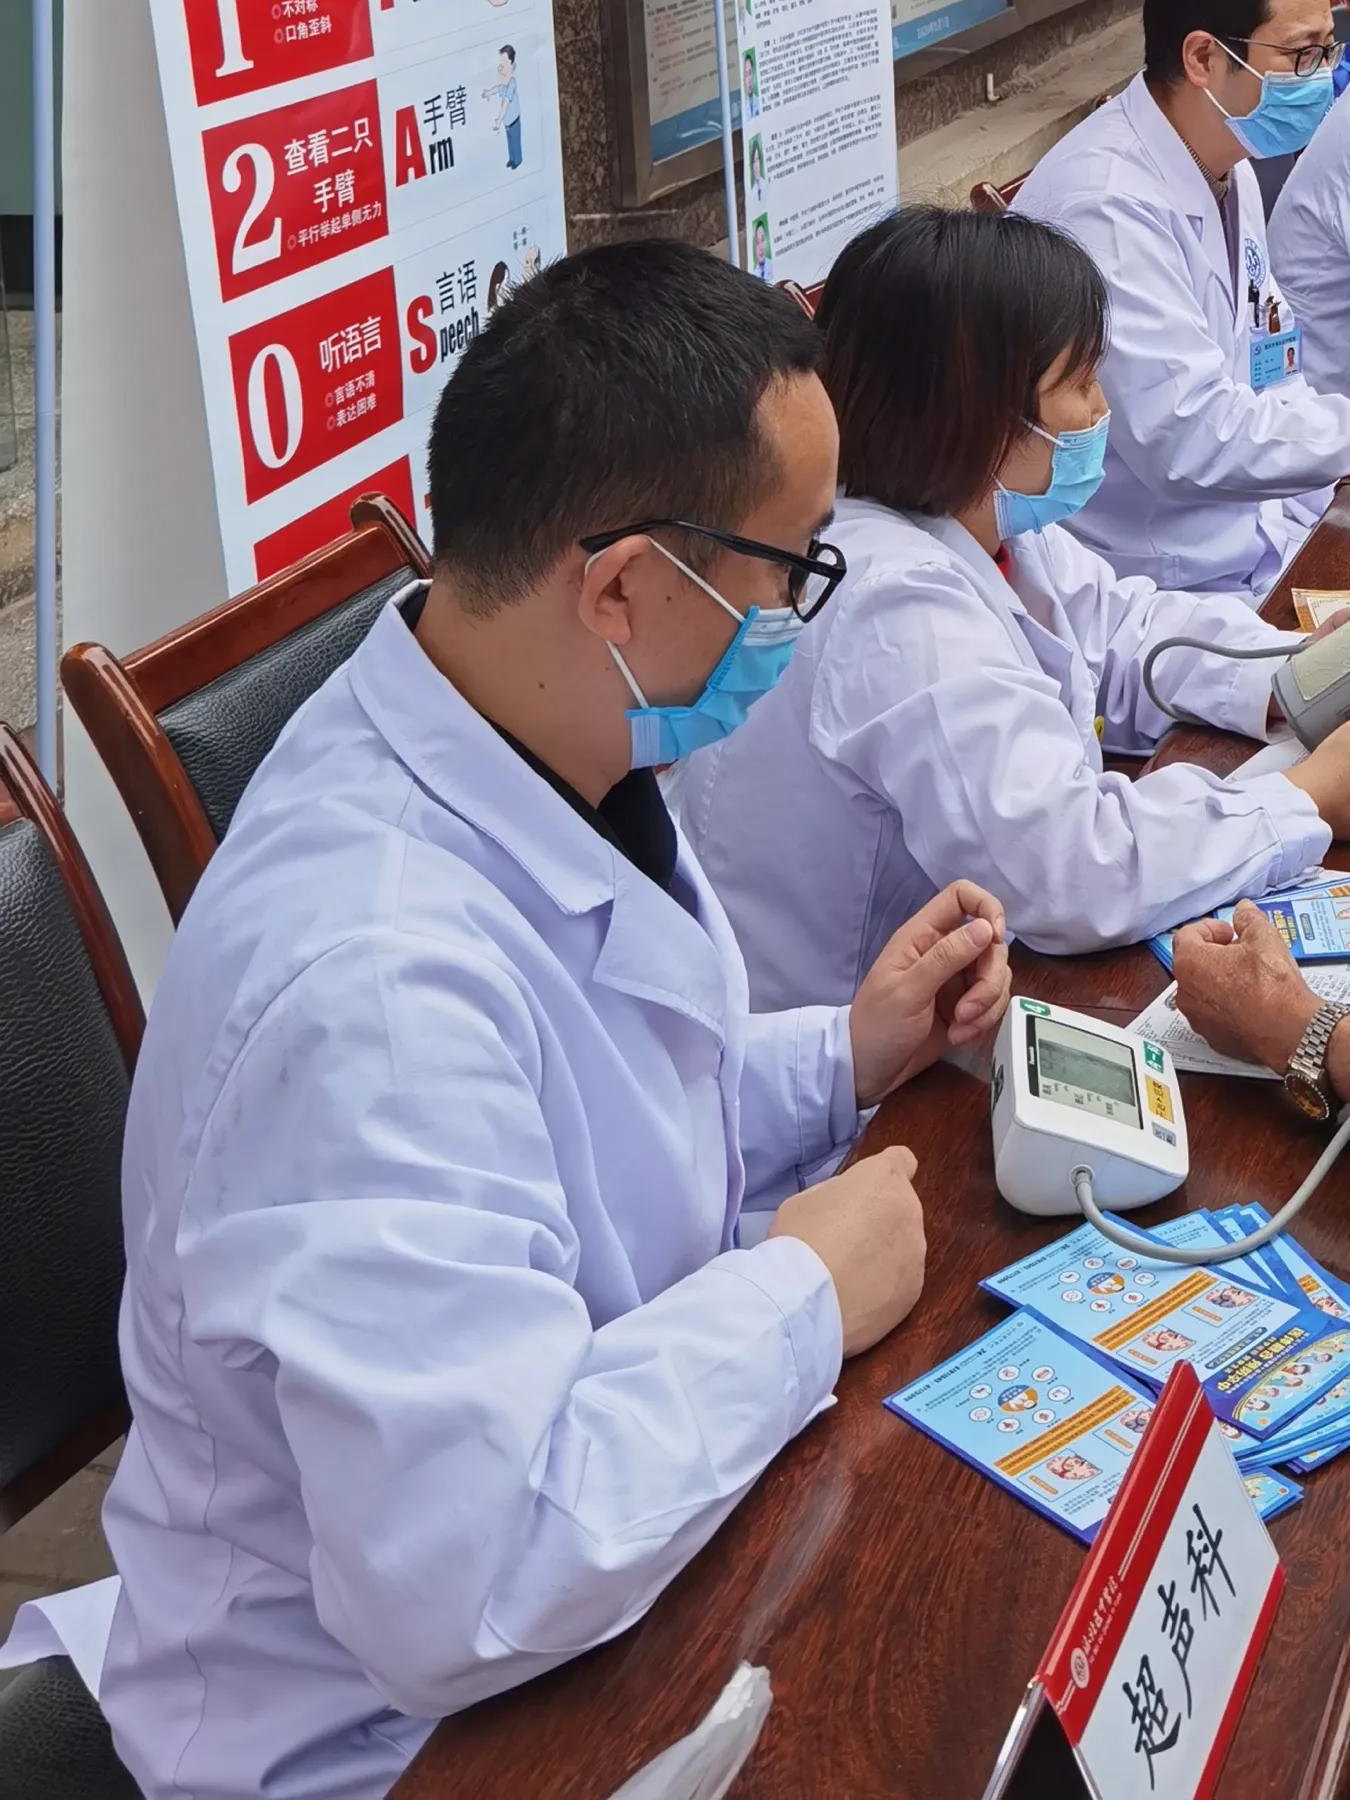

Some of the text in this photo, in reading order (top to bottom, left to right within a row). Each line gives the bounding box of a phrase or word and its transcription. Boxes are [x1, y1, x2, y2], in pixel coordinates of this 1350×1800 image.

[285, 16, 333, 44] 口角歪斜
[422, 84, 468, 138] 手臂
[284, 116, 374, 175] 查看二只
[222, 142, 282, 276] 2
[313, 166, 357, 211] 手臂
[297, 199, 383, 248] 平行举起单侧无力
[435, 259, 478, 314] 言语
[319, 315, 383, 374] 听语言
[247, 342, 304, 470] 0
[333, 370, 376, 406] 言语不清
[334, 392, 378, 431] 表达困难
[1122, 1503, 1238, 1790] 超声科
